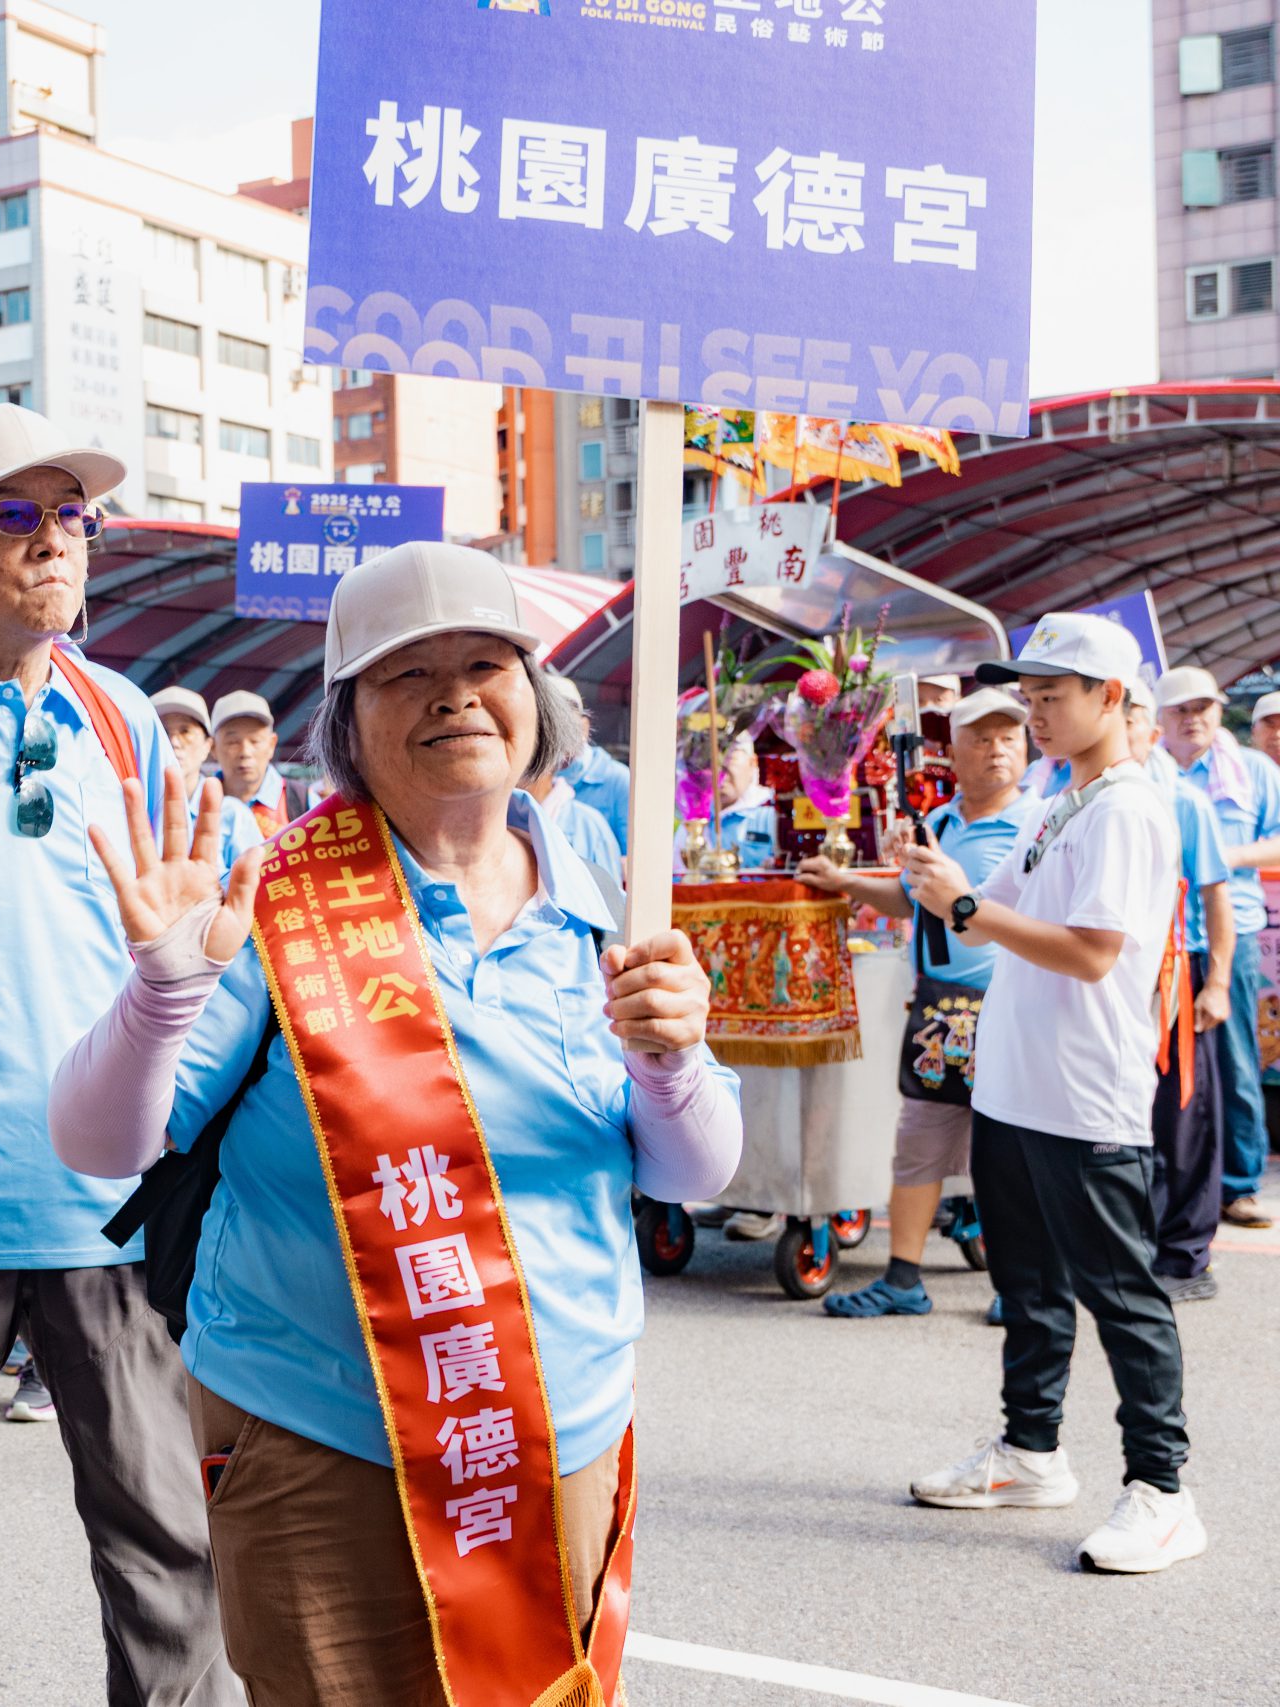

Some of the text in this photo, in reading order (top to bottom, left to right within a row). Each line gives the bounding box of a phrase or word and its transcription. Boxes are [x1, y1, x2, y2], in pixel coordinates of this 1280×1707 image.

[581, 7, 705, 31] FOLK ARTS FESTIVAL
[645, 0, 706, 19] GONG
[715, 13, 884, 51] 民俗藝術節
[362, 100, 987, 271] 桃園廣德宮
[250, 541, 395, 576] 桃園南
[286, 850, 309, 866] DI
[314, 838, 371, 859] GONG
[265, 876, 338, 1036] 民俗藝術節
[299, 872, 356, 1028] FOLK ARTS FESTIVAL
[326, 866, 421, 1024] 土地公
[371, 1144, 519, 1559] 桃園廣德宮
